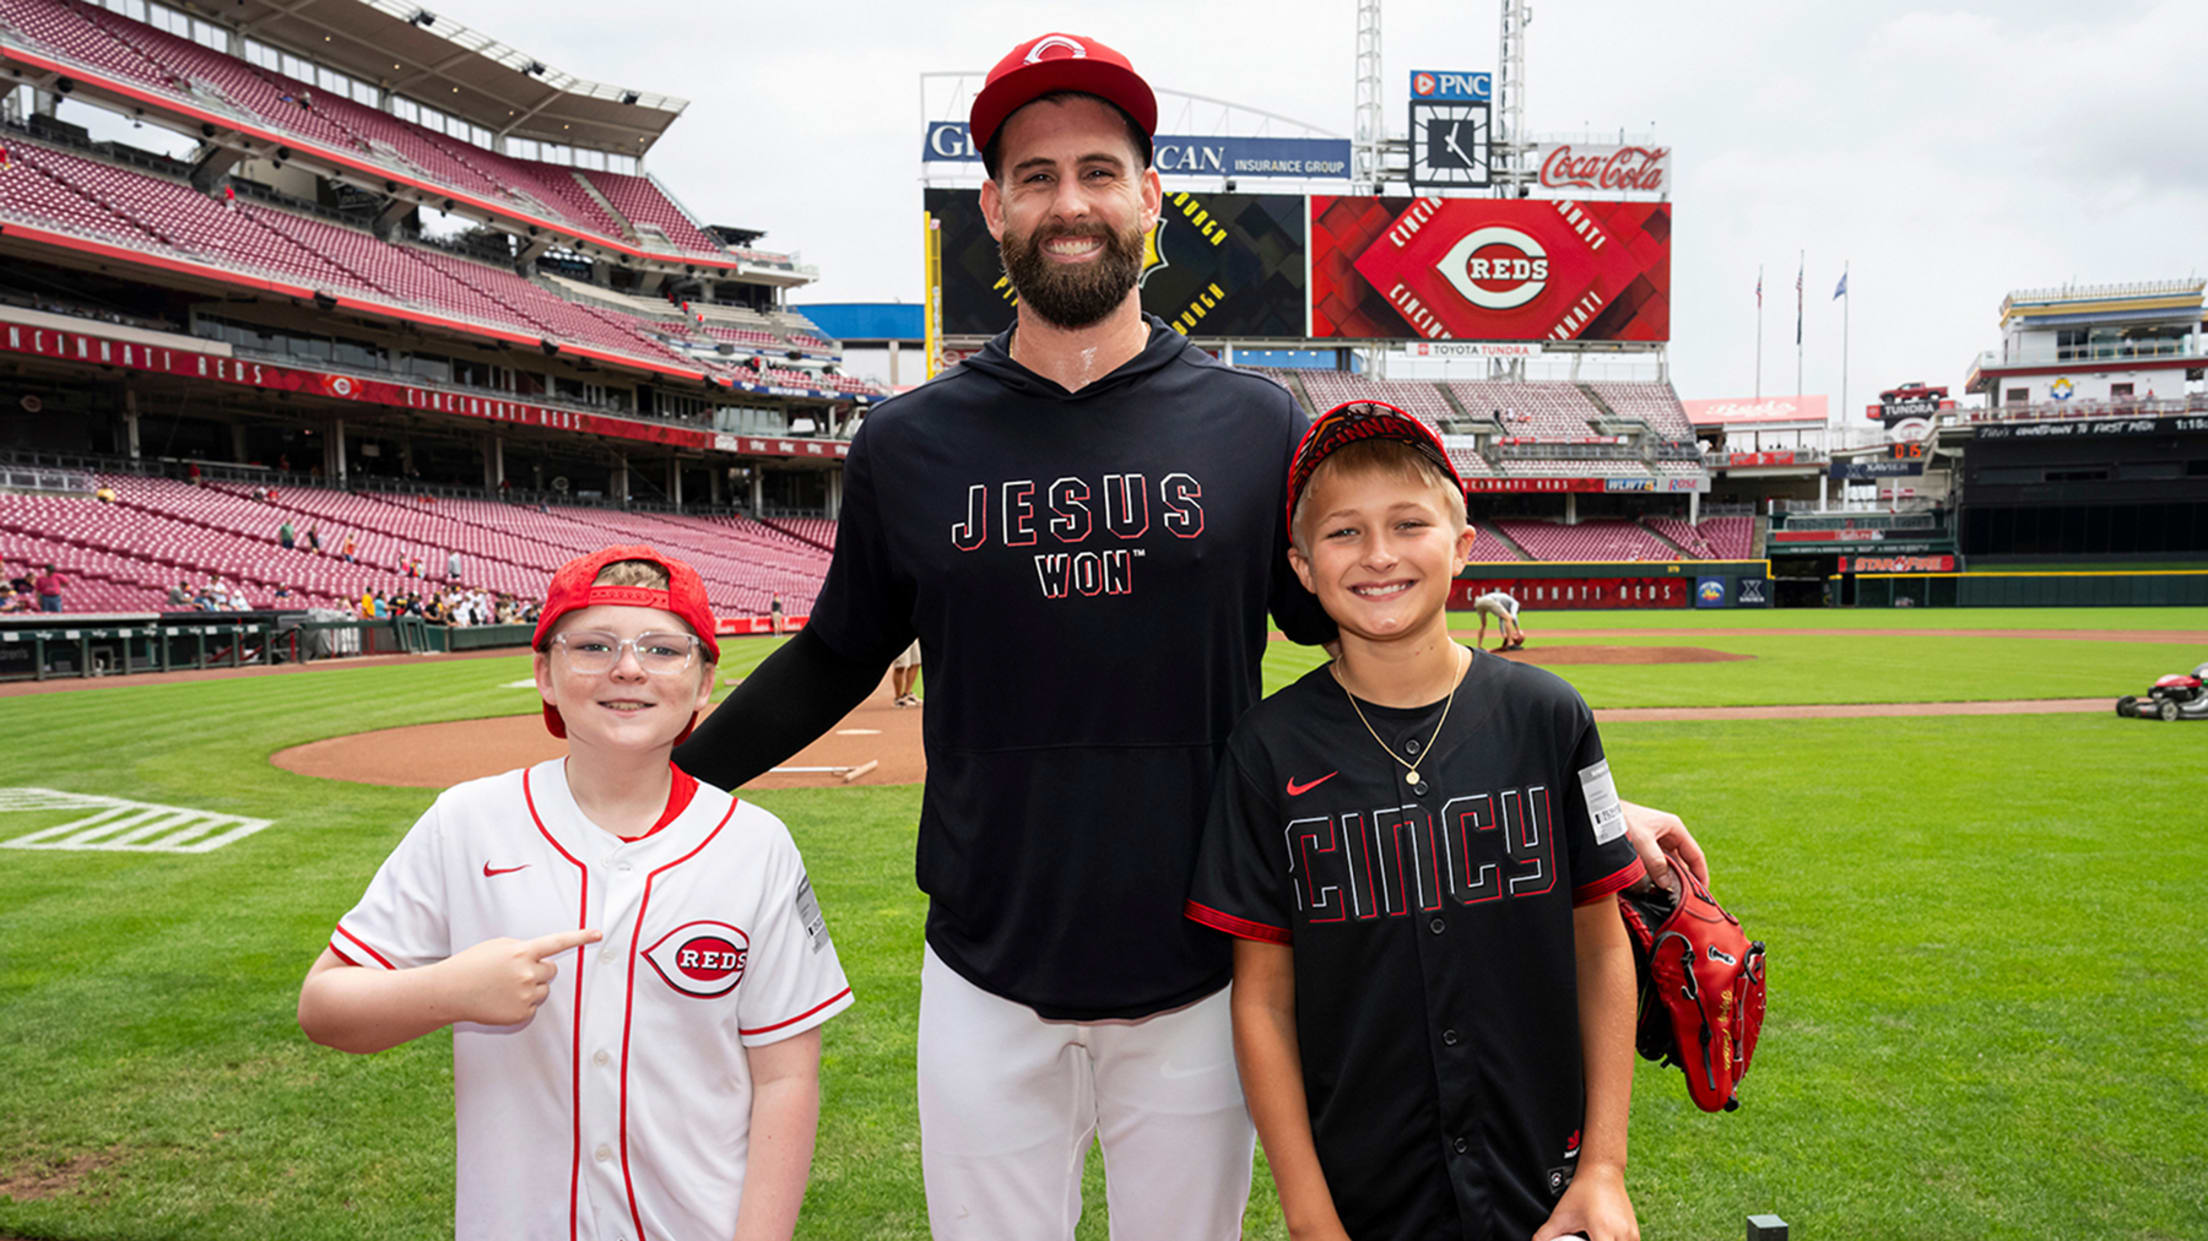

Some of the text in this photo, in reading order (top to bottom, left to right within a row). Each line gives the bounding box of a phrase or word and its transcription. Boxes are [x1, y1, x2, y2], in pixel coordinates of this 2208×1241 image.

[1439, 75, 1490, 95] PNC
[1153, 144, 1225, 171] CAN
[1235, 160, 1345, 174] INSURANCE GROUP
[1540, 145, 1670, 190] Coca-Cola
[1165, 192, 1228, 246] BURGH
[1389, 197, 1443, 247] CINCIN
[1469, 258, 1549, 281] REDS
[1172, 282, 1225, 336] BURGH
[9, 326, 262, 384] NCINNATI REDS
[1434, 345, 1530, 355] TOYOTA TUNDRA
[541, 409, 580, 430] REDS
[1884, 403, 1936, 416] TUNDRA
[952, 473, 1204, 551] JESUS
[1034, 550, 1132, 599] WON
[1620, 586, 1670, 599] REDS
[1283, 786, 1559, 924] CINCY
[680, 948, 748, 971] REDS
